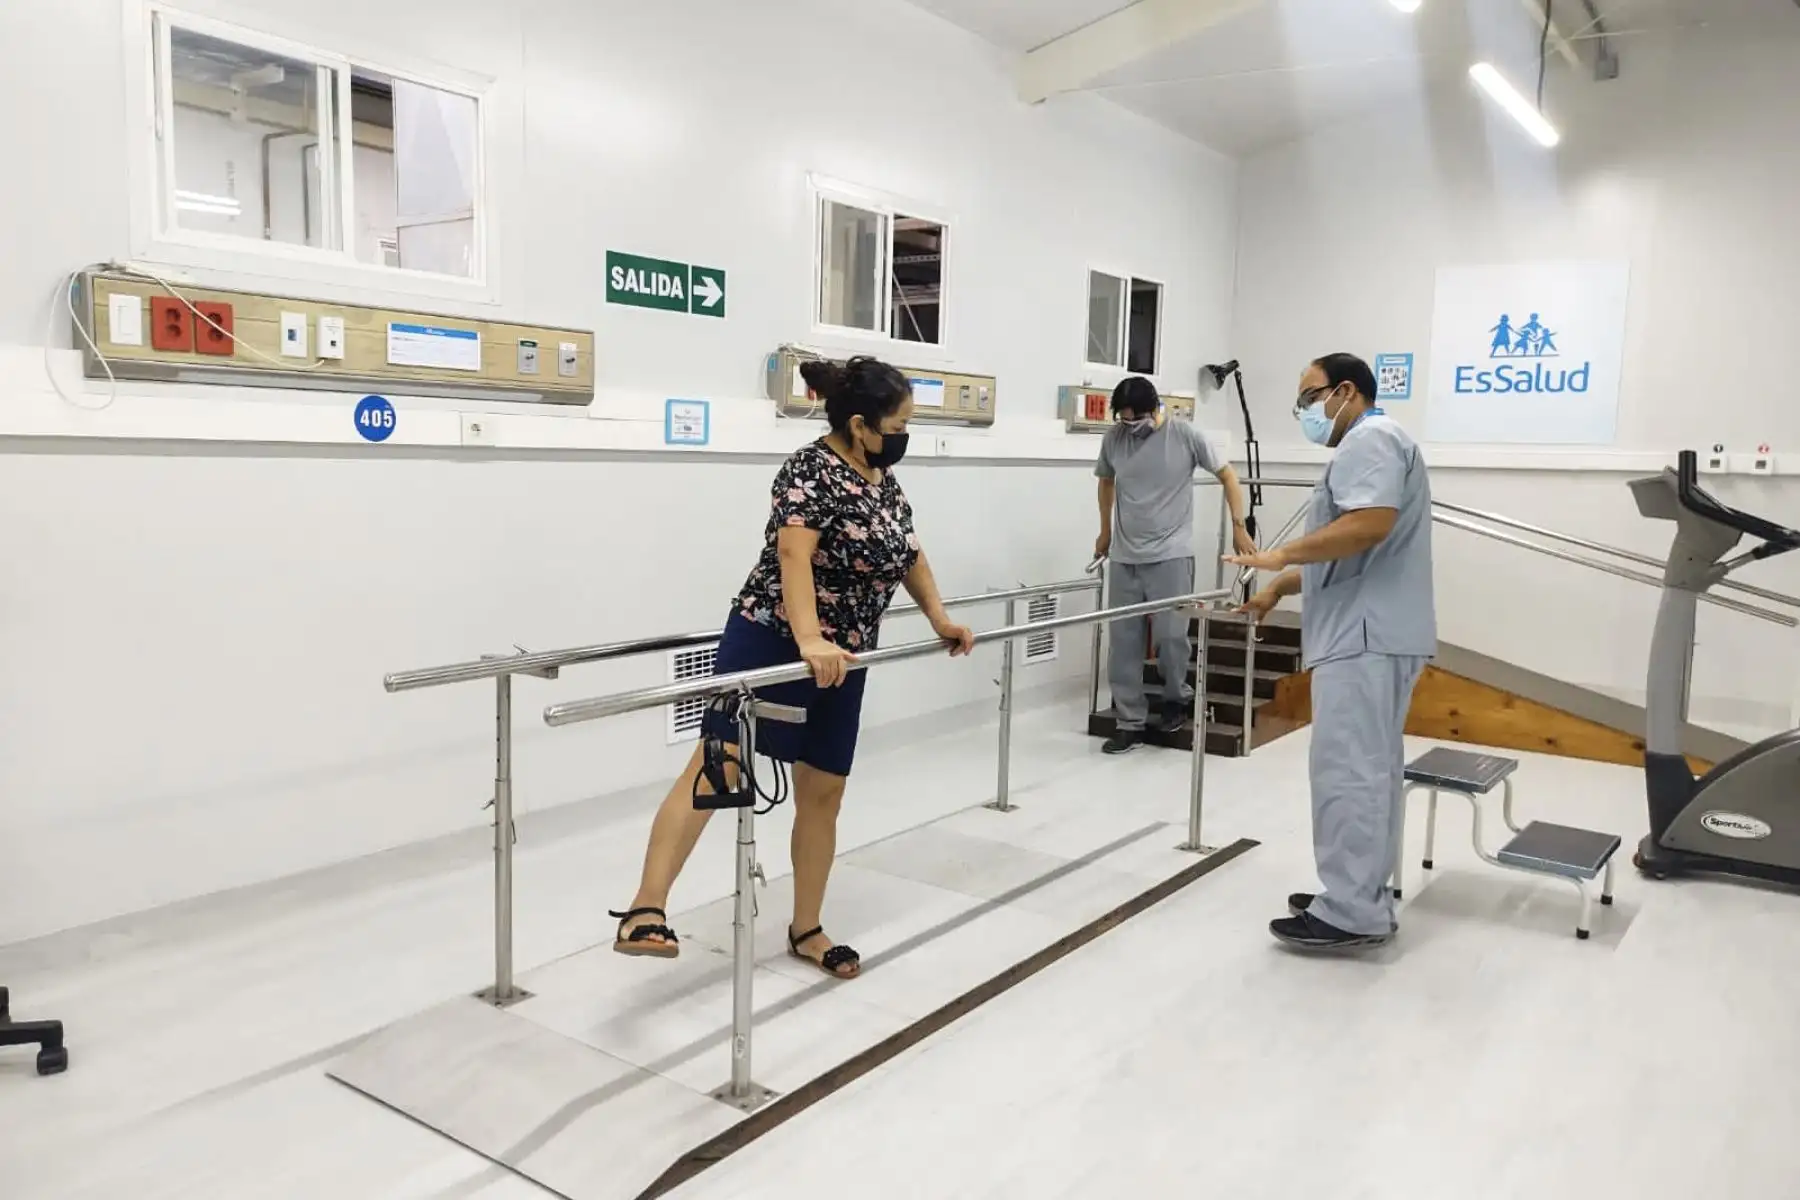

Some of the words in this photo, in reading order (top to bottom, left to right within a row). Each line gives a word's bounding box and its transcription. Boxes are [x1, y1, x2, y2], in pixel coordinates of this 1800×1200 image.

[611, 265, 684, 299] SALIDA
[1455, 361, 1589, 393] EsSalud
[360, 409, 393, 428] 405
